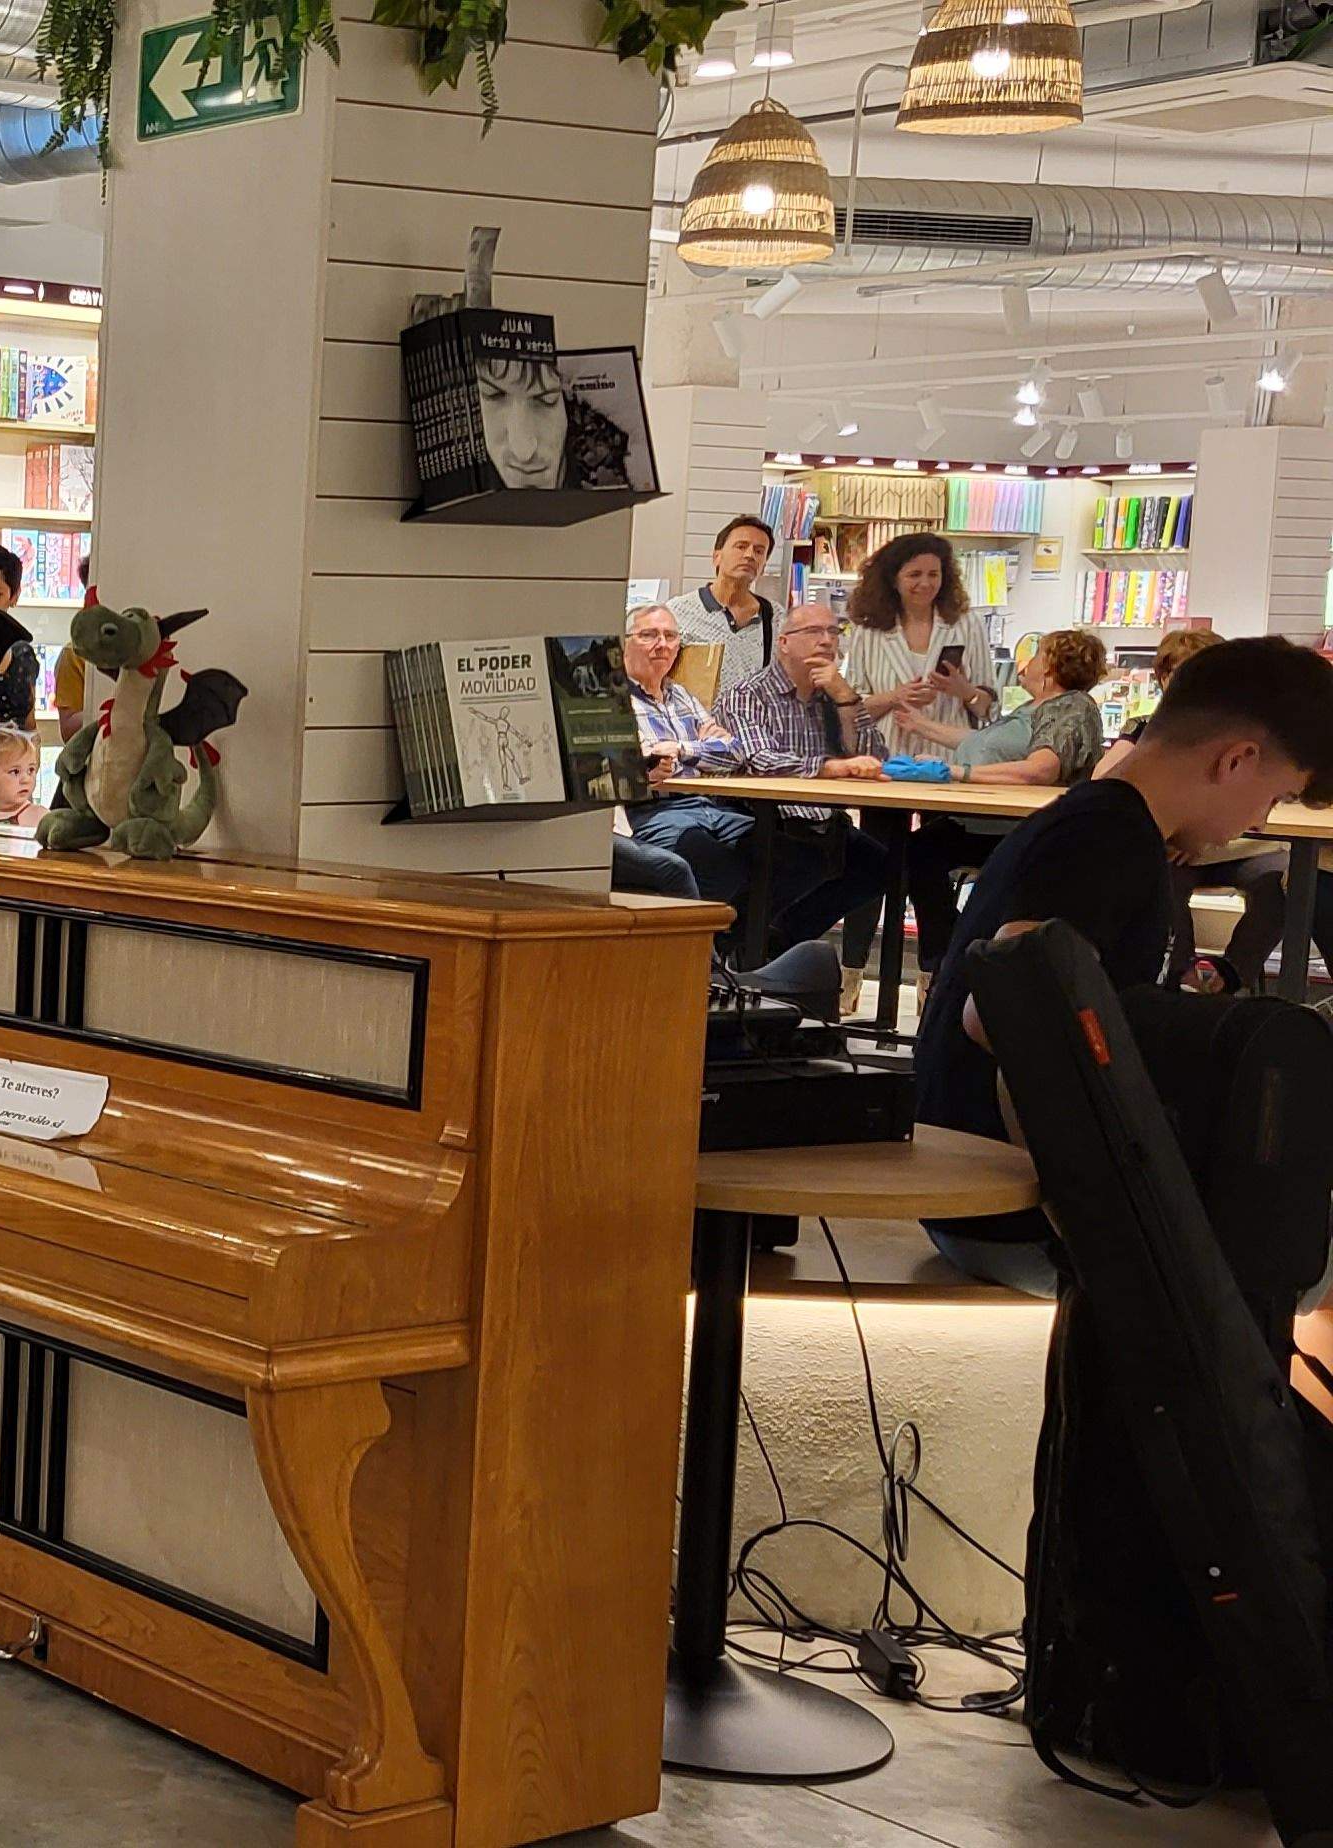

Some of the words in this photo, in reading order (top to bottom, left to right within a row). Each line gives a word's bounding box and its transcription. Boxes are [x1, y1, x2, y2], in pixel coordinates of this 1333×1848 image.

[501, 317, 532, 334] JUAN
[457, 658, 475, 672] EL
[478, 654, 532, 672] PODER
[485, 672, 495, 680] DE
[496, 671, 506, 679] LA
[460, 677, 536, 695] MOVILIDAD
[0, 1108, 25, 1123] pero
[27, 1112, 50, 1126] sólo
[52, 1118, 65, 1129] si
